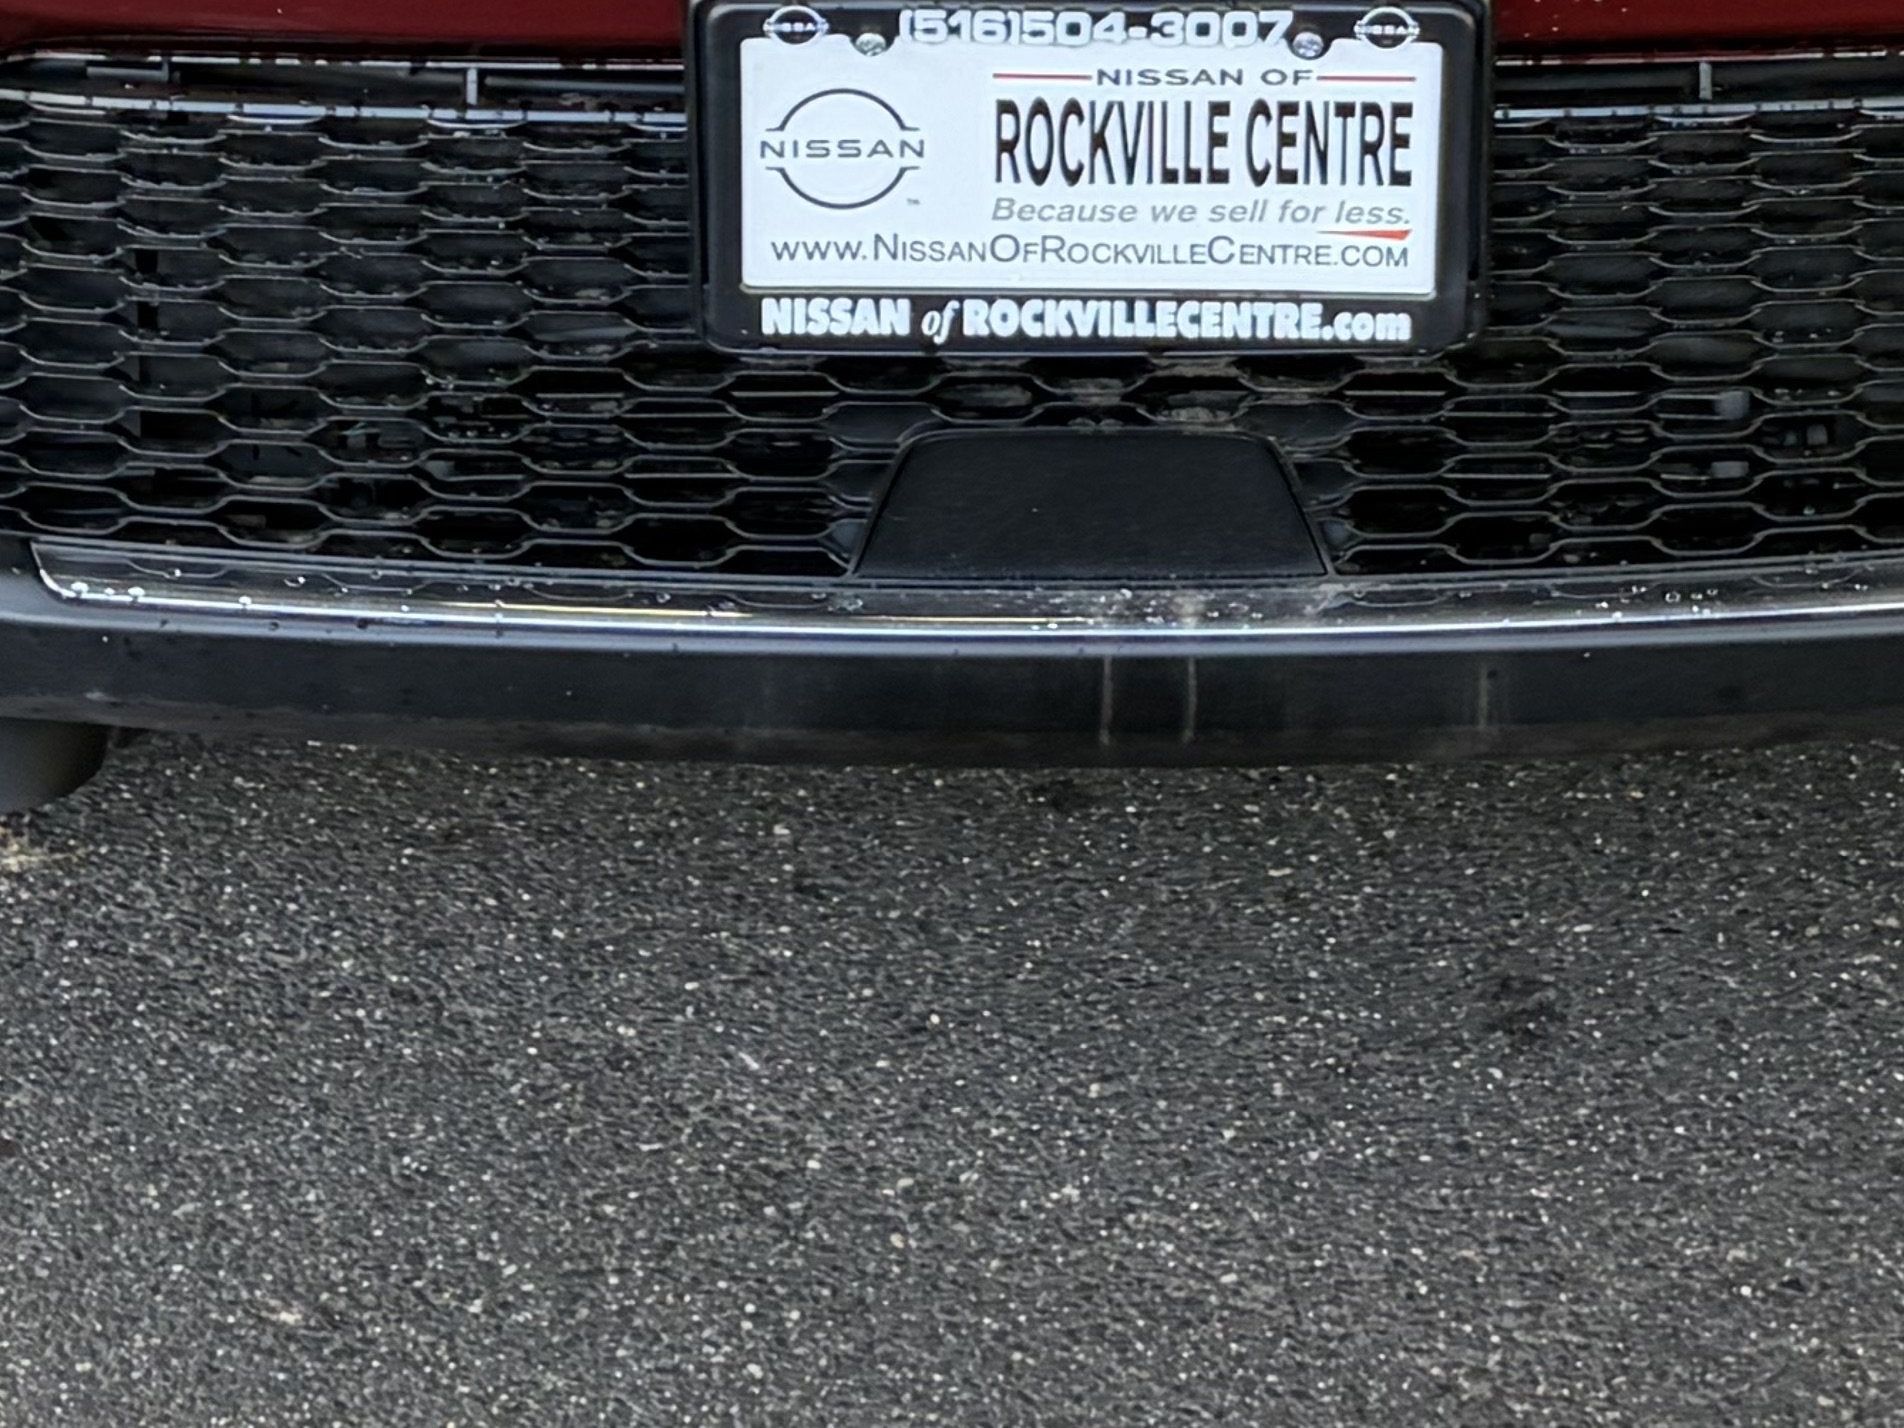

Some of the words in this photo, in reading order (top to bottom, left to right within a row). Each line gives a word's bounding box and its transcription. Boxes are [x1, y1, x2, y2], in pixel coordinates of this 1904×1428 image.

[898, 9, 1295, 48] (516)504-3007
[1096, 66, 1245, 88] NISSAN
[1261, 66, 1314, 89] OF
[760, 138, 925, 159] NISSAN
[995, 96, 1232, 188] ROCKVILLE
[1245, 97, 1414, 188] CENTRE
[991, 197, 1138, 224] Because
[1151, 203, 1197, 224] we
[1208, 198, 1269, 224] sell
[1277, 199, 1327, 225] for
[1335, 200, 1412, 226] less.
[761, 297, 911, 336] NISSAN
[921, 299, 960, 345] of
[962, 298, 1413, 342] ROCKVILLECENTRE.com
